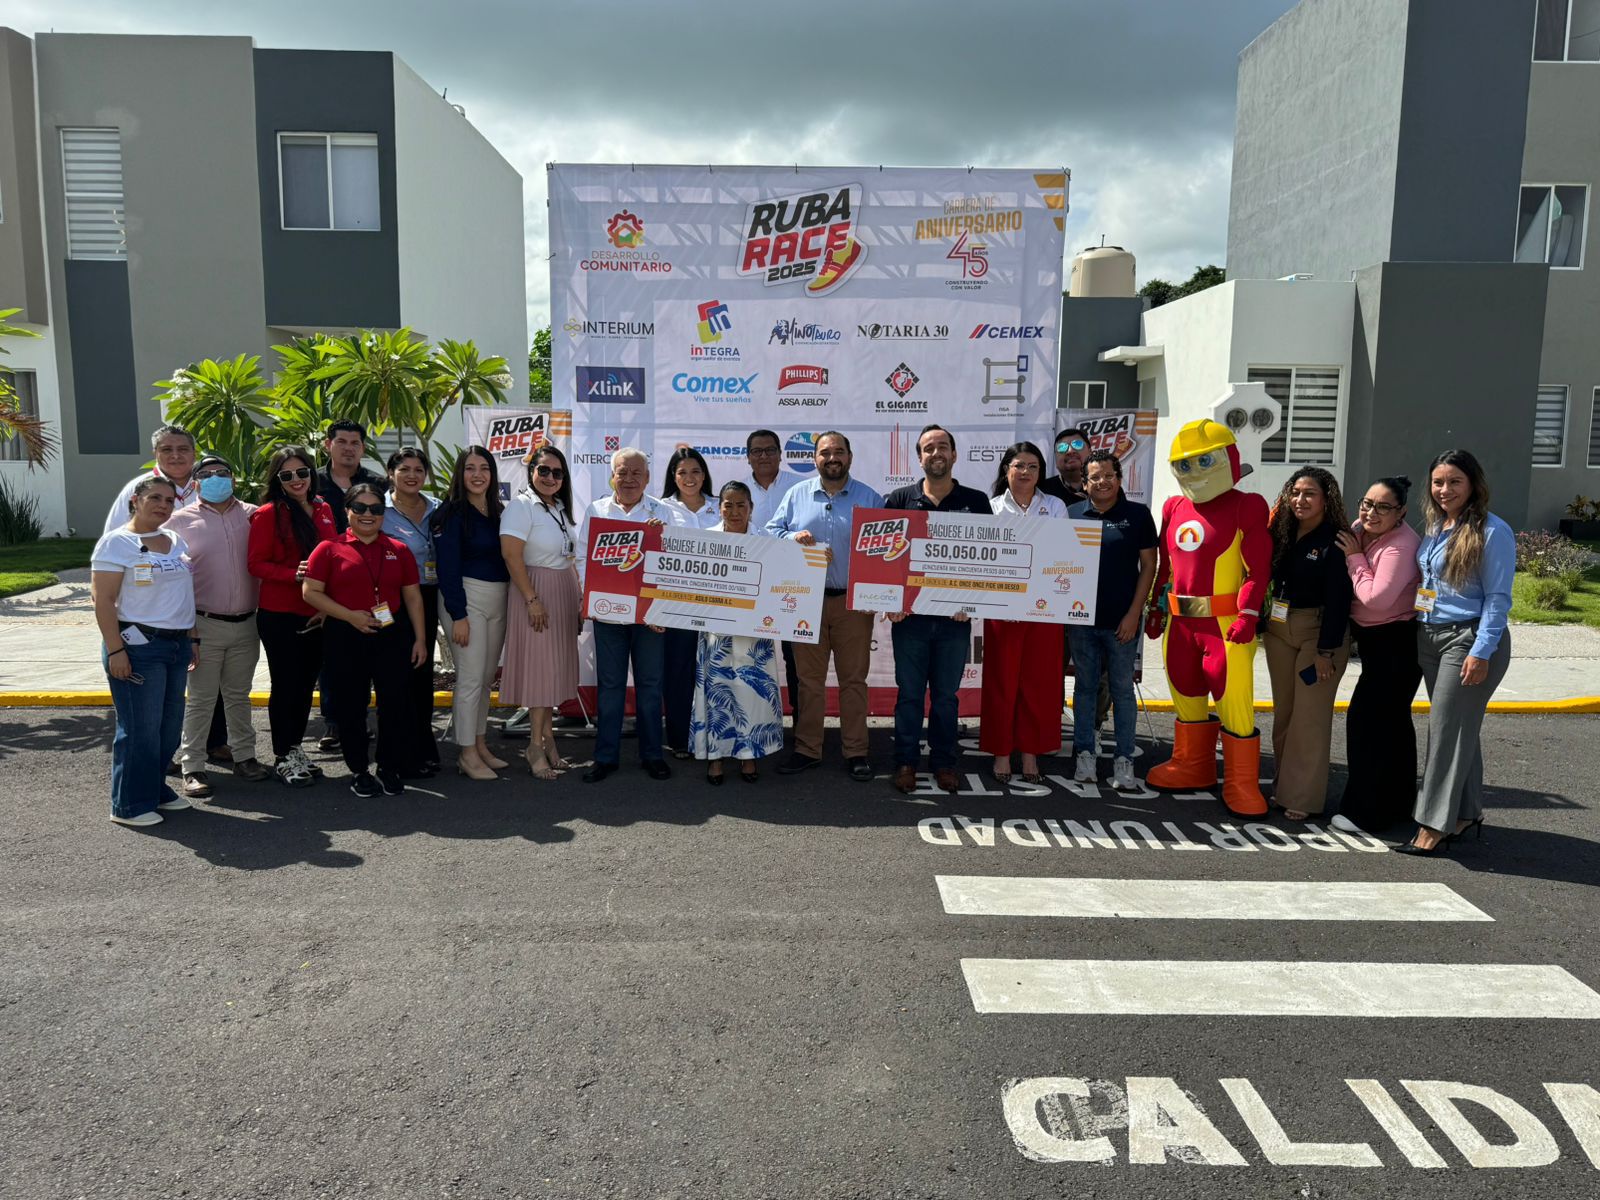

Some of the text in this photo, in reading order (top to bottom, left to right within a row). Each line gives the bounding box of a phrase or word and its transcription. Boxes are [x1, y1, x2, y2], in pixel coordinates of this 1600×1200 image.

[748, 188, 851, 239] RUBA
[944, 196, 996, 215] CARRERA DE
[915, 210, 1023, 240] ANIVERSARIO
[742, 221, 851, 272] RACE
[946, 229, 989, 278] 45
[592, 250, 660, 260] DESARROLLO
[580, 260, 672, 272] COMUNITARIO
[767, 260, 818, 282] 2025
[583, 321, 655, 335] INTERIUM
[857, 323, 949, 339] NOTARIA 30
[988, 326, 1045, 338] CEMEX
[690, 344, 741, 356] inTEGRA
[785, 369, 819, 380] PHILLIPS
[672, 372, 759, 394] Comex
[725, 395, 752, 403] sueños
[875, 401, 928, 409] EL GIGANTE
[491, 415, 544, 436] RUBA
[1080, 415, 1129, 435] RUBA
[489, 431, 544, 452] RACE
[1089, 431, 1129, 449] ACE
[502, 448, 527, 457] 2025
[861, 520, 904, 536] RUBA
[928, 522, 1016, 542] PÁGUESE LA SUMA DE:
[597, 532, 639, 546] RUBA
[858, 533, 904, 549] RACE
[594, 545, 639, 559] RACE
[662, 536, 747, 559] PÁGUESE LA SUMA DE:
[925, 543, 998, 561] $50,050.00
[658, 556, 747, 577] $50,050.00 mxn
[1042, 566, 1085, 575] ANIVERSARIO
[770, 584, 811, 594] ANIVERSARIO
